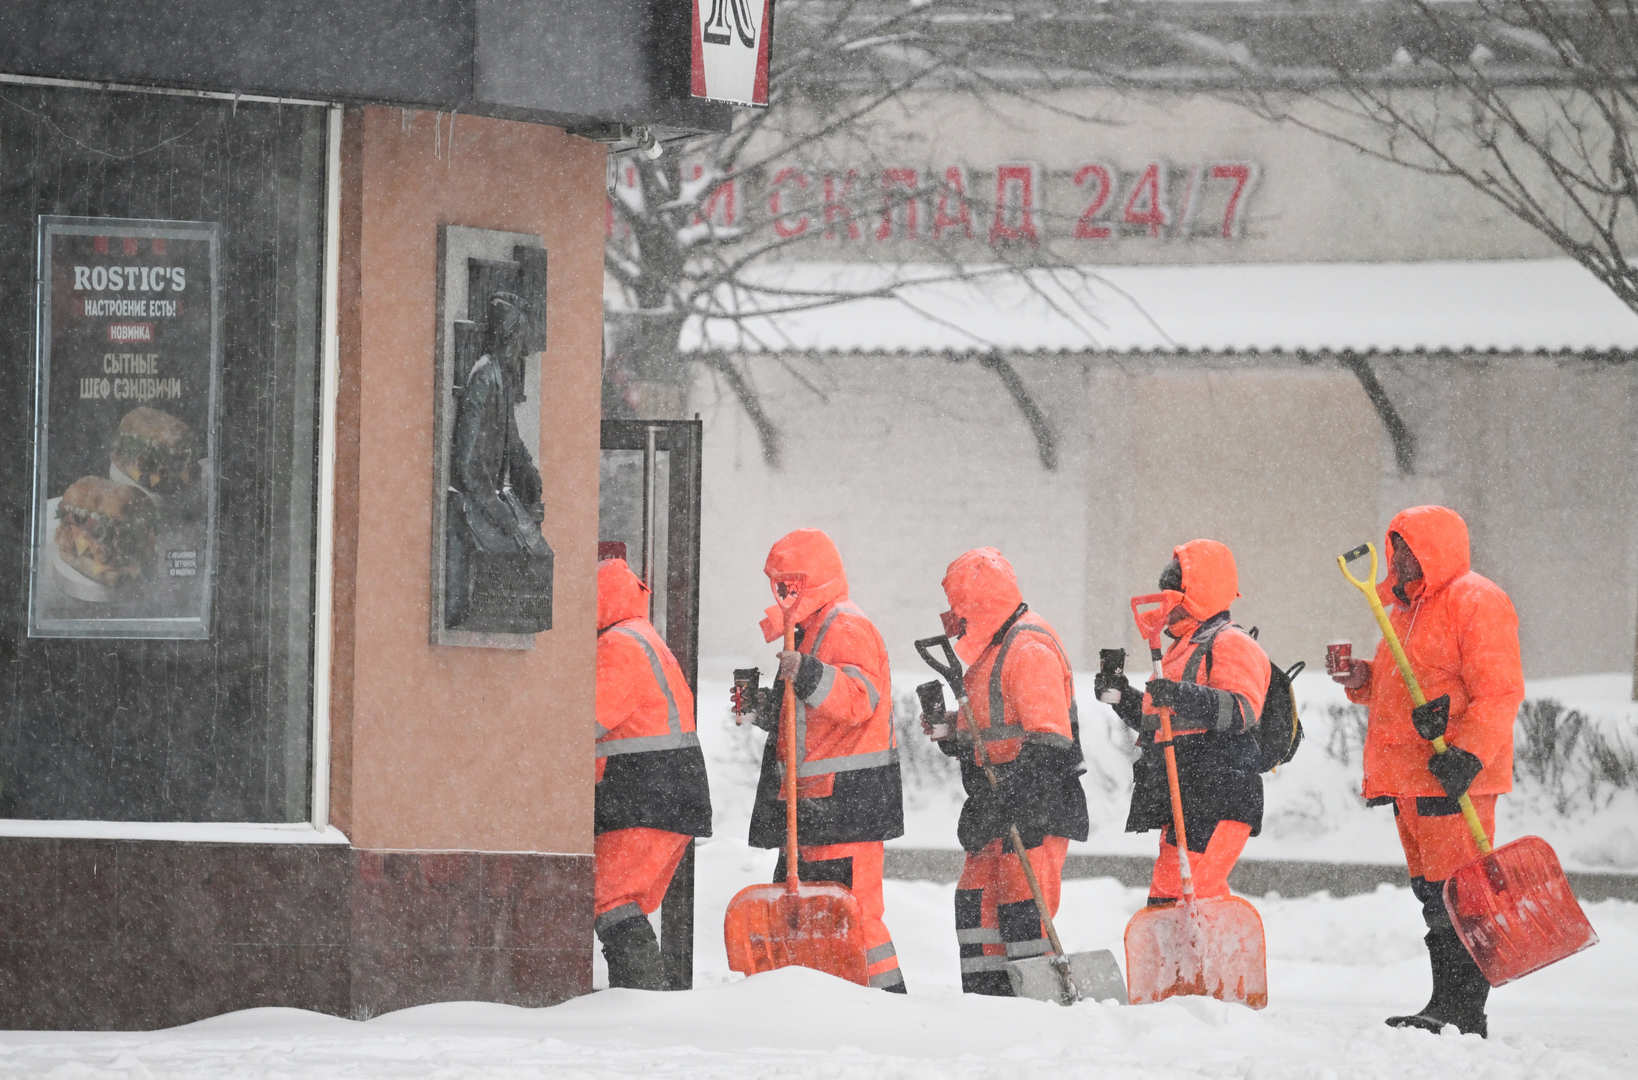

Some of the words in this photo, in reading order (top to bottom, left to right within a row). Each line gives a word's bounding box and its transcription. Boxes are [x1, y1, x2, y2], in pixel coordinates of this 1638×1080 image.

[768, 165, 1041, 249] СКЛАД
[1072, 164, 1250, 239] 24/7
[73, 266, 186, 292] ROSTIC'S
[84, 299, 147, 317] НАСТРОЕНИЕ
[149, 300, 176, 317] ЕСТЬ!
[110, 325, 151, 340] НОВИНКА
[103, 352, 159, 375] СЫТНЫЕ
[80, 378, 111, 399] ШЕФ
[113, 378, 181, 402] СЭНДВИЧИ
